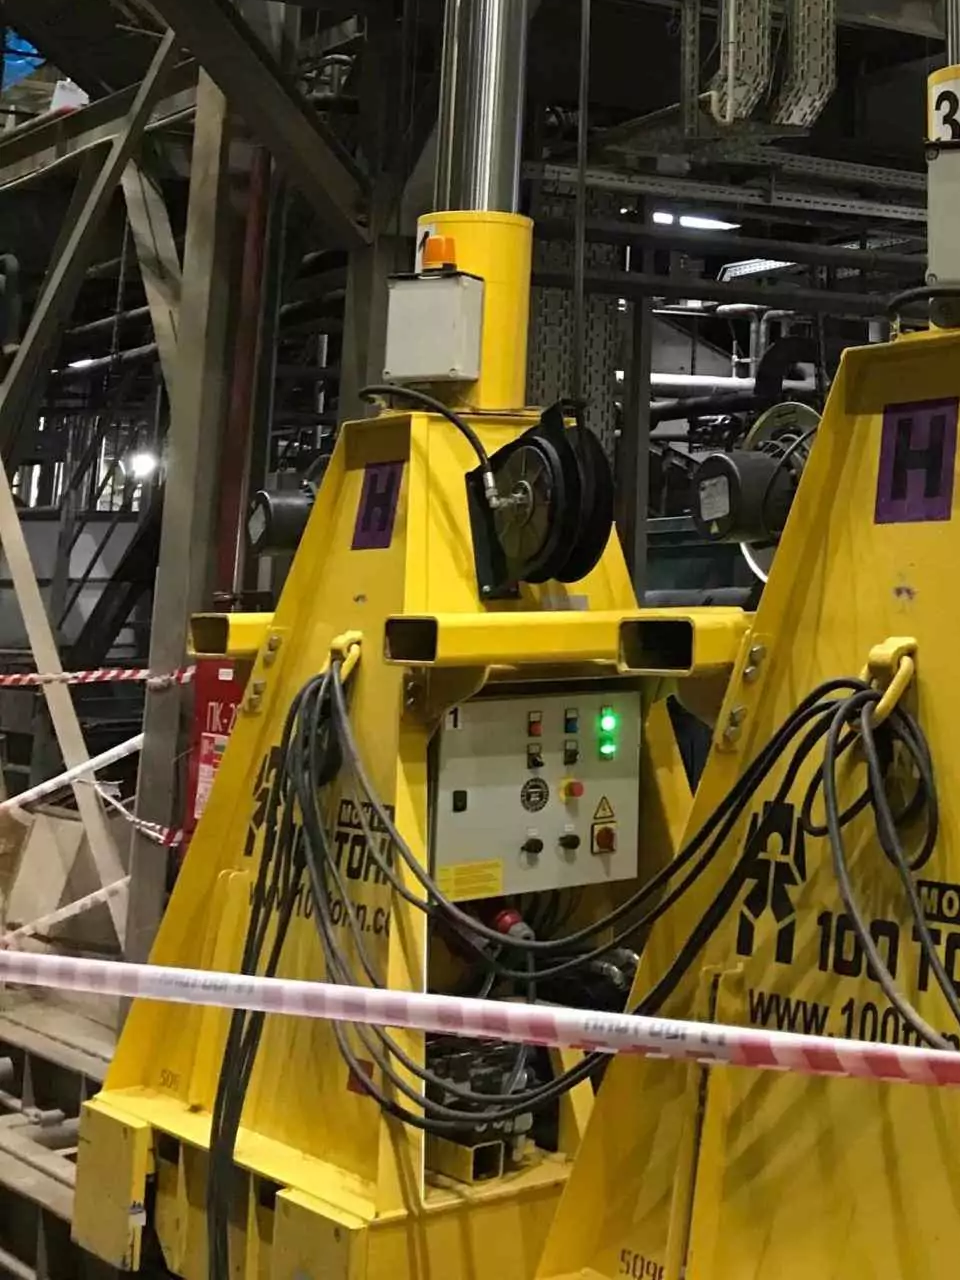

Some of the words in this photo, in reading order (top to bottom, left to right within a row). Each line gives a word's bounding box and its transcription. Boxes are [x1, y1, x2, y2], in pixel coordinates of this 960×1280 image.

[207, 701, 241, 734] ПК-2
[449, 706, 459, 729] 1
[817, 910, 900, 983] 100
